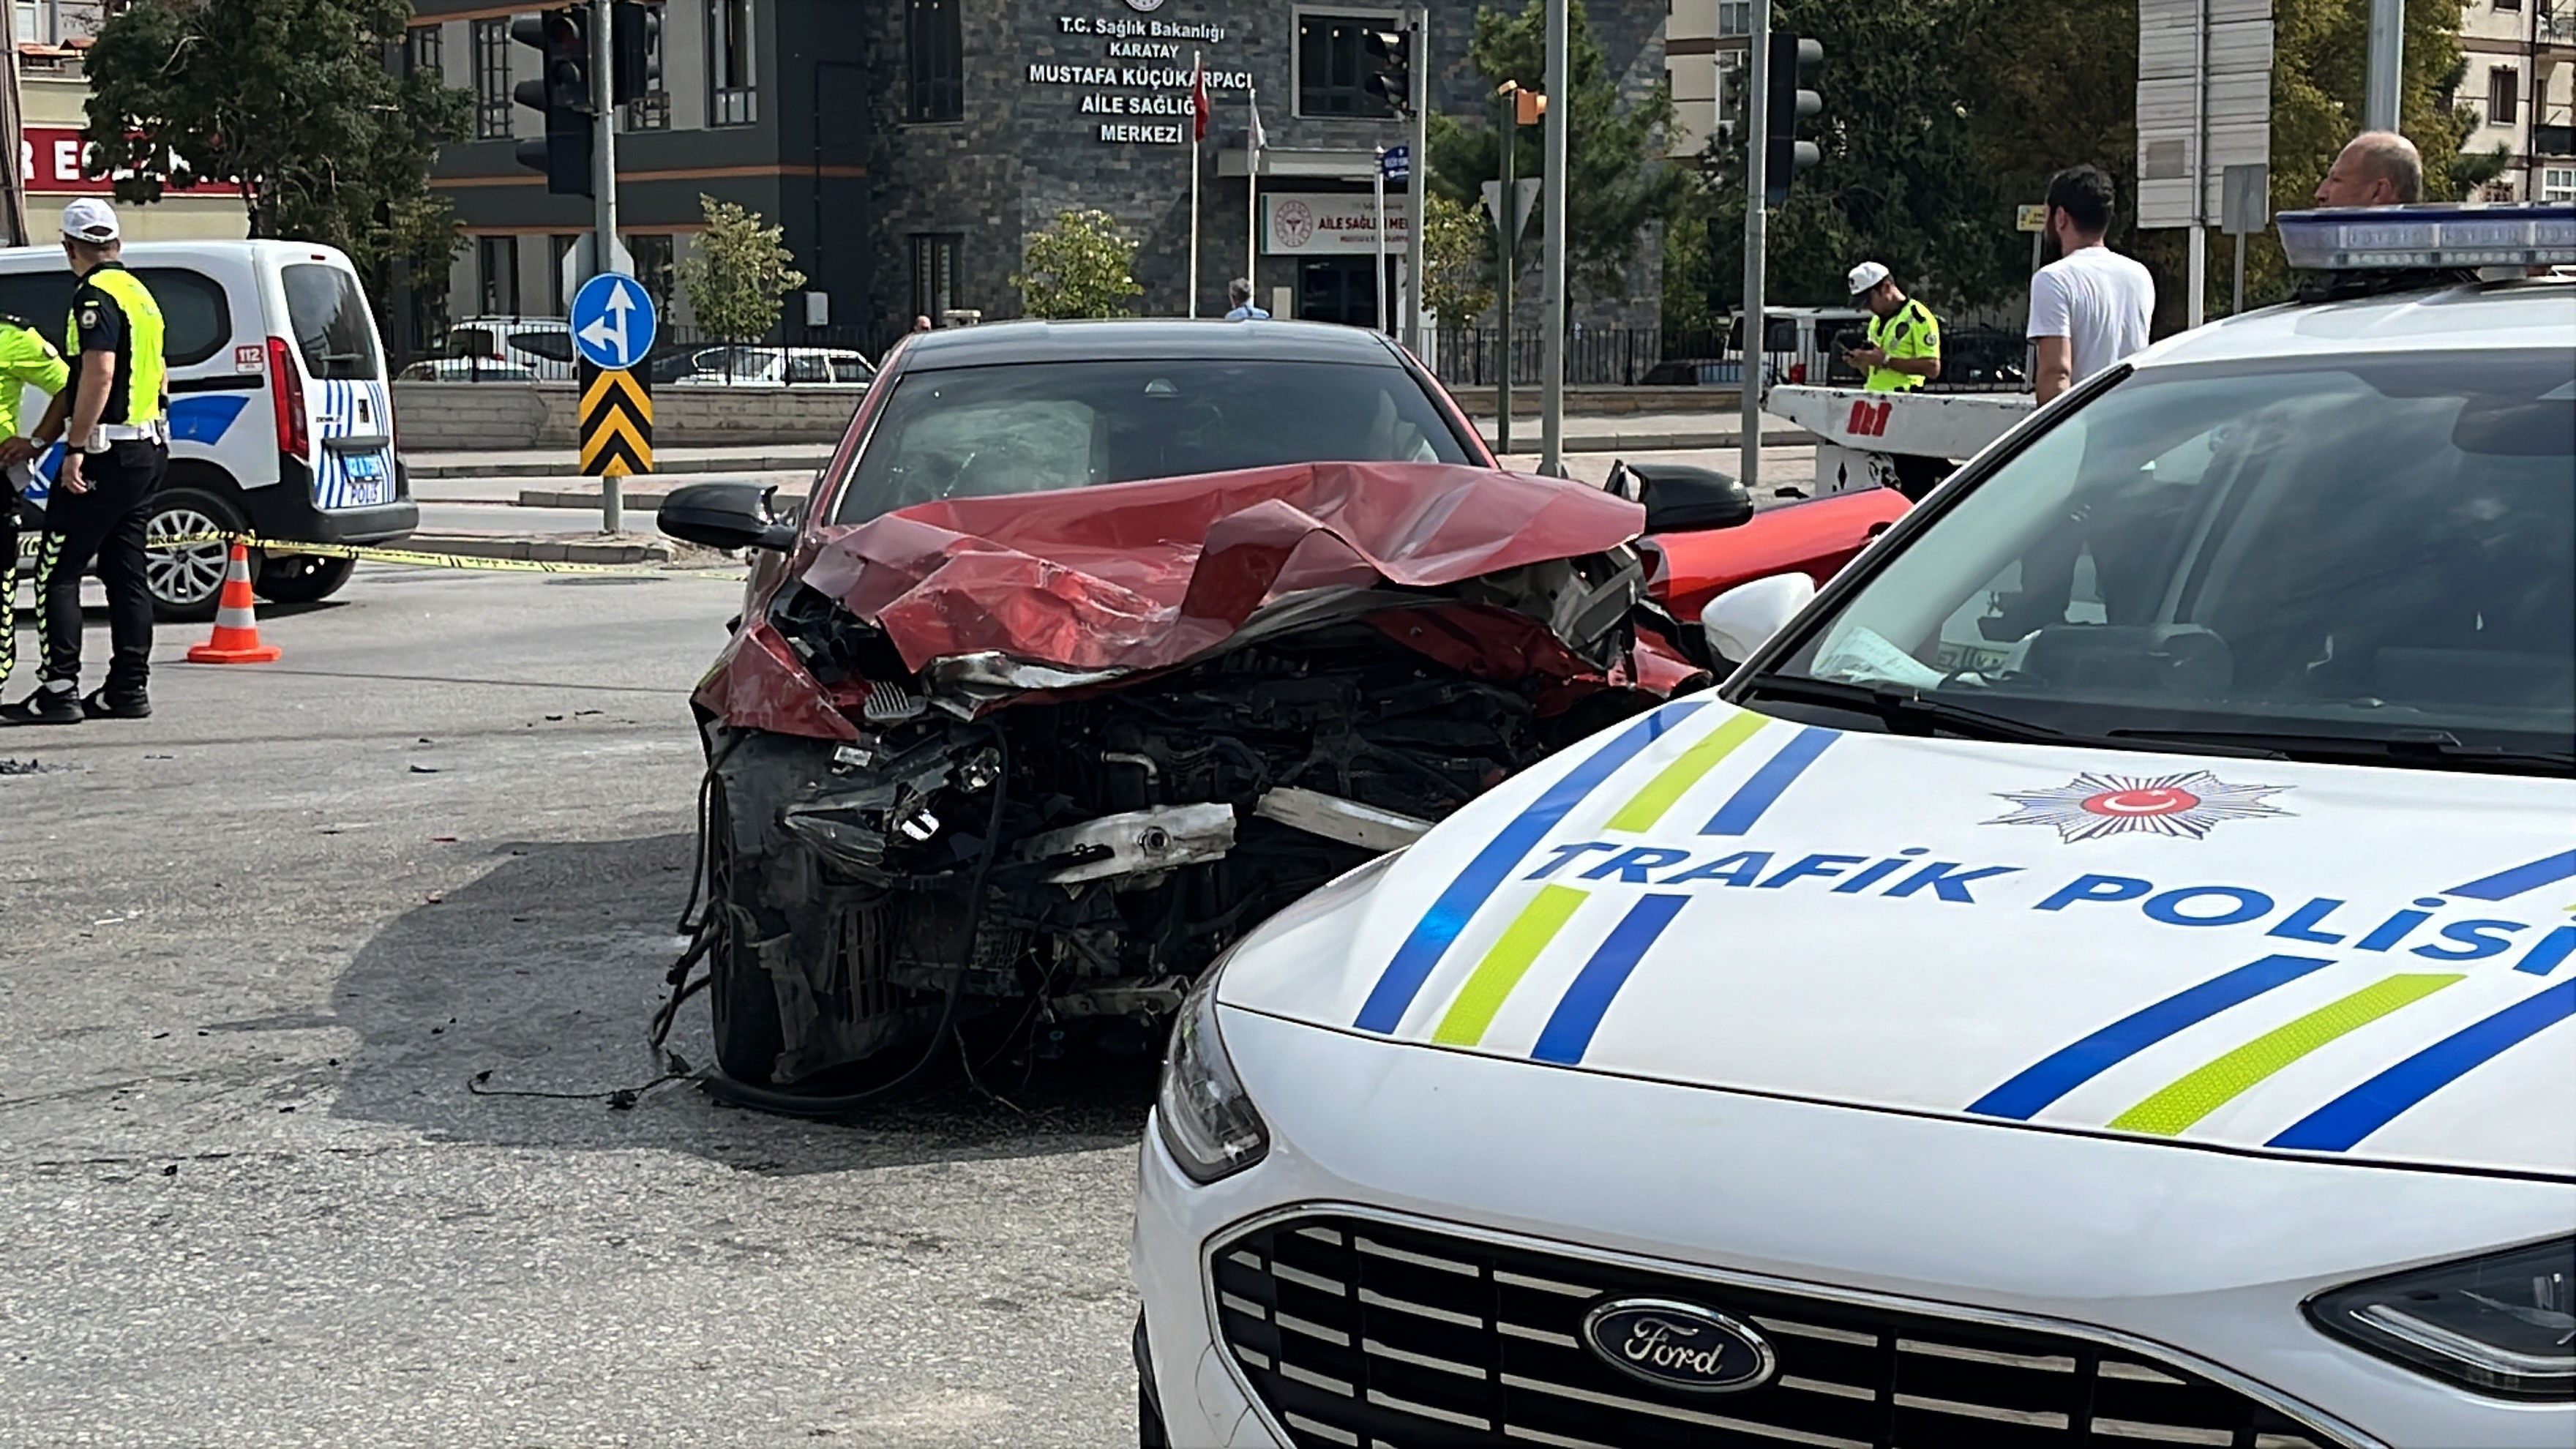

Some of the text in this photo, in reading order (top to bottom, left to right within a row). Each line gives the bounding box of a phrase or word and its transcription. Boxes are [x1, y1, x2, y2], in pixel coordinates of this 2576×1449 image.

[1060, 17, 1224, 42] T.C. Sağlık Bakanlığı
[1110, 42, 1180, 59] KARATAY
[1030, 65, 1117, 86] MUSTAFA
[1081, 94, 1196, 116] AİLE SAĞLIĞ
[1101, 124, 1183, 143] MERKEZİ
[1346, 214, 1388, 230] SAĞLII
[1390, 217, 1408, 230] ME
[238, 348, 261, 362] 112
[1624, 1317, 1725, 1375] Ford
